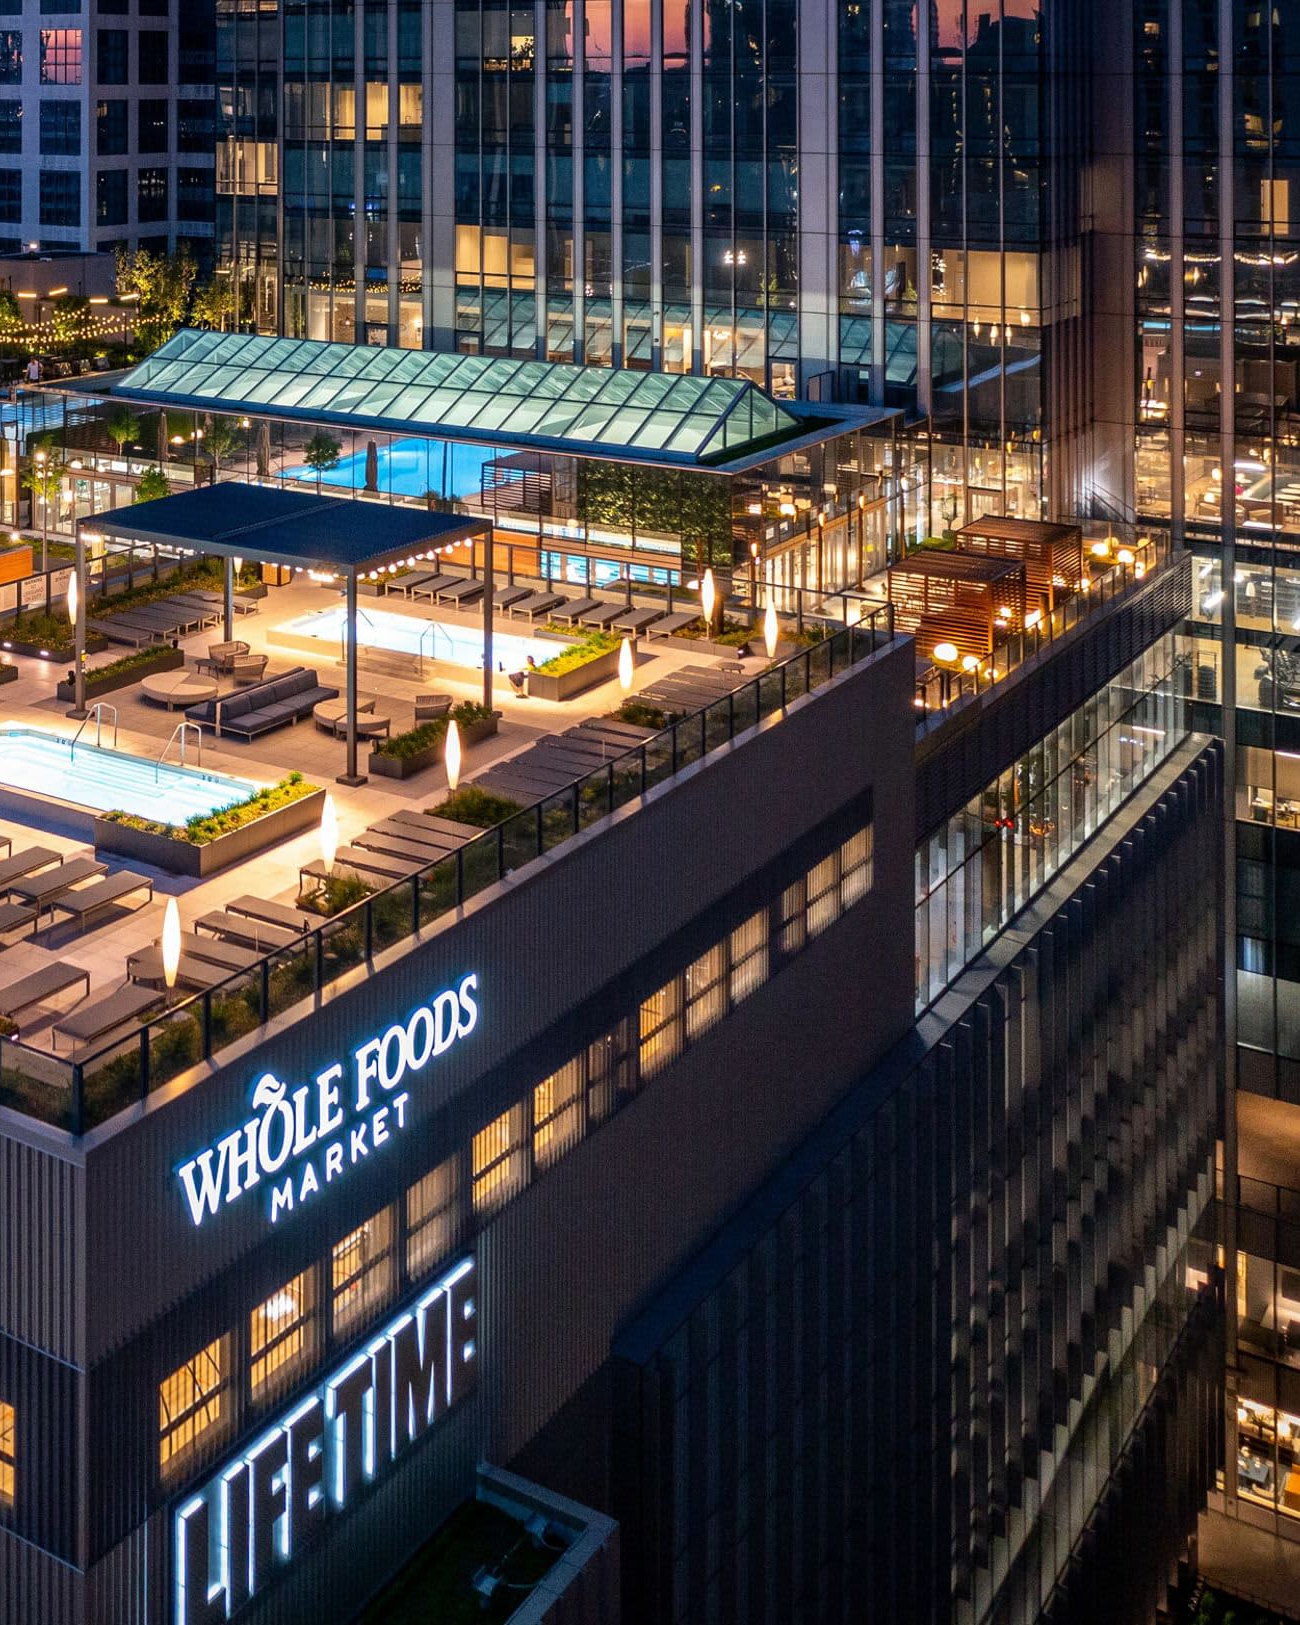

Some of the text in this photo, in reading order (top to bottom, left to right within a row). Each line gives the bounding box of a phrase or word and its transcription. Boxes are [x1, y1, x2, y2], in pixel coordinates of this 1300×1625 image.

[178, 973, 478, 1226] WHOLE FOODS
[270, 1092, 409, 1223] MARKET
